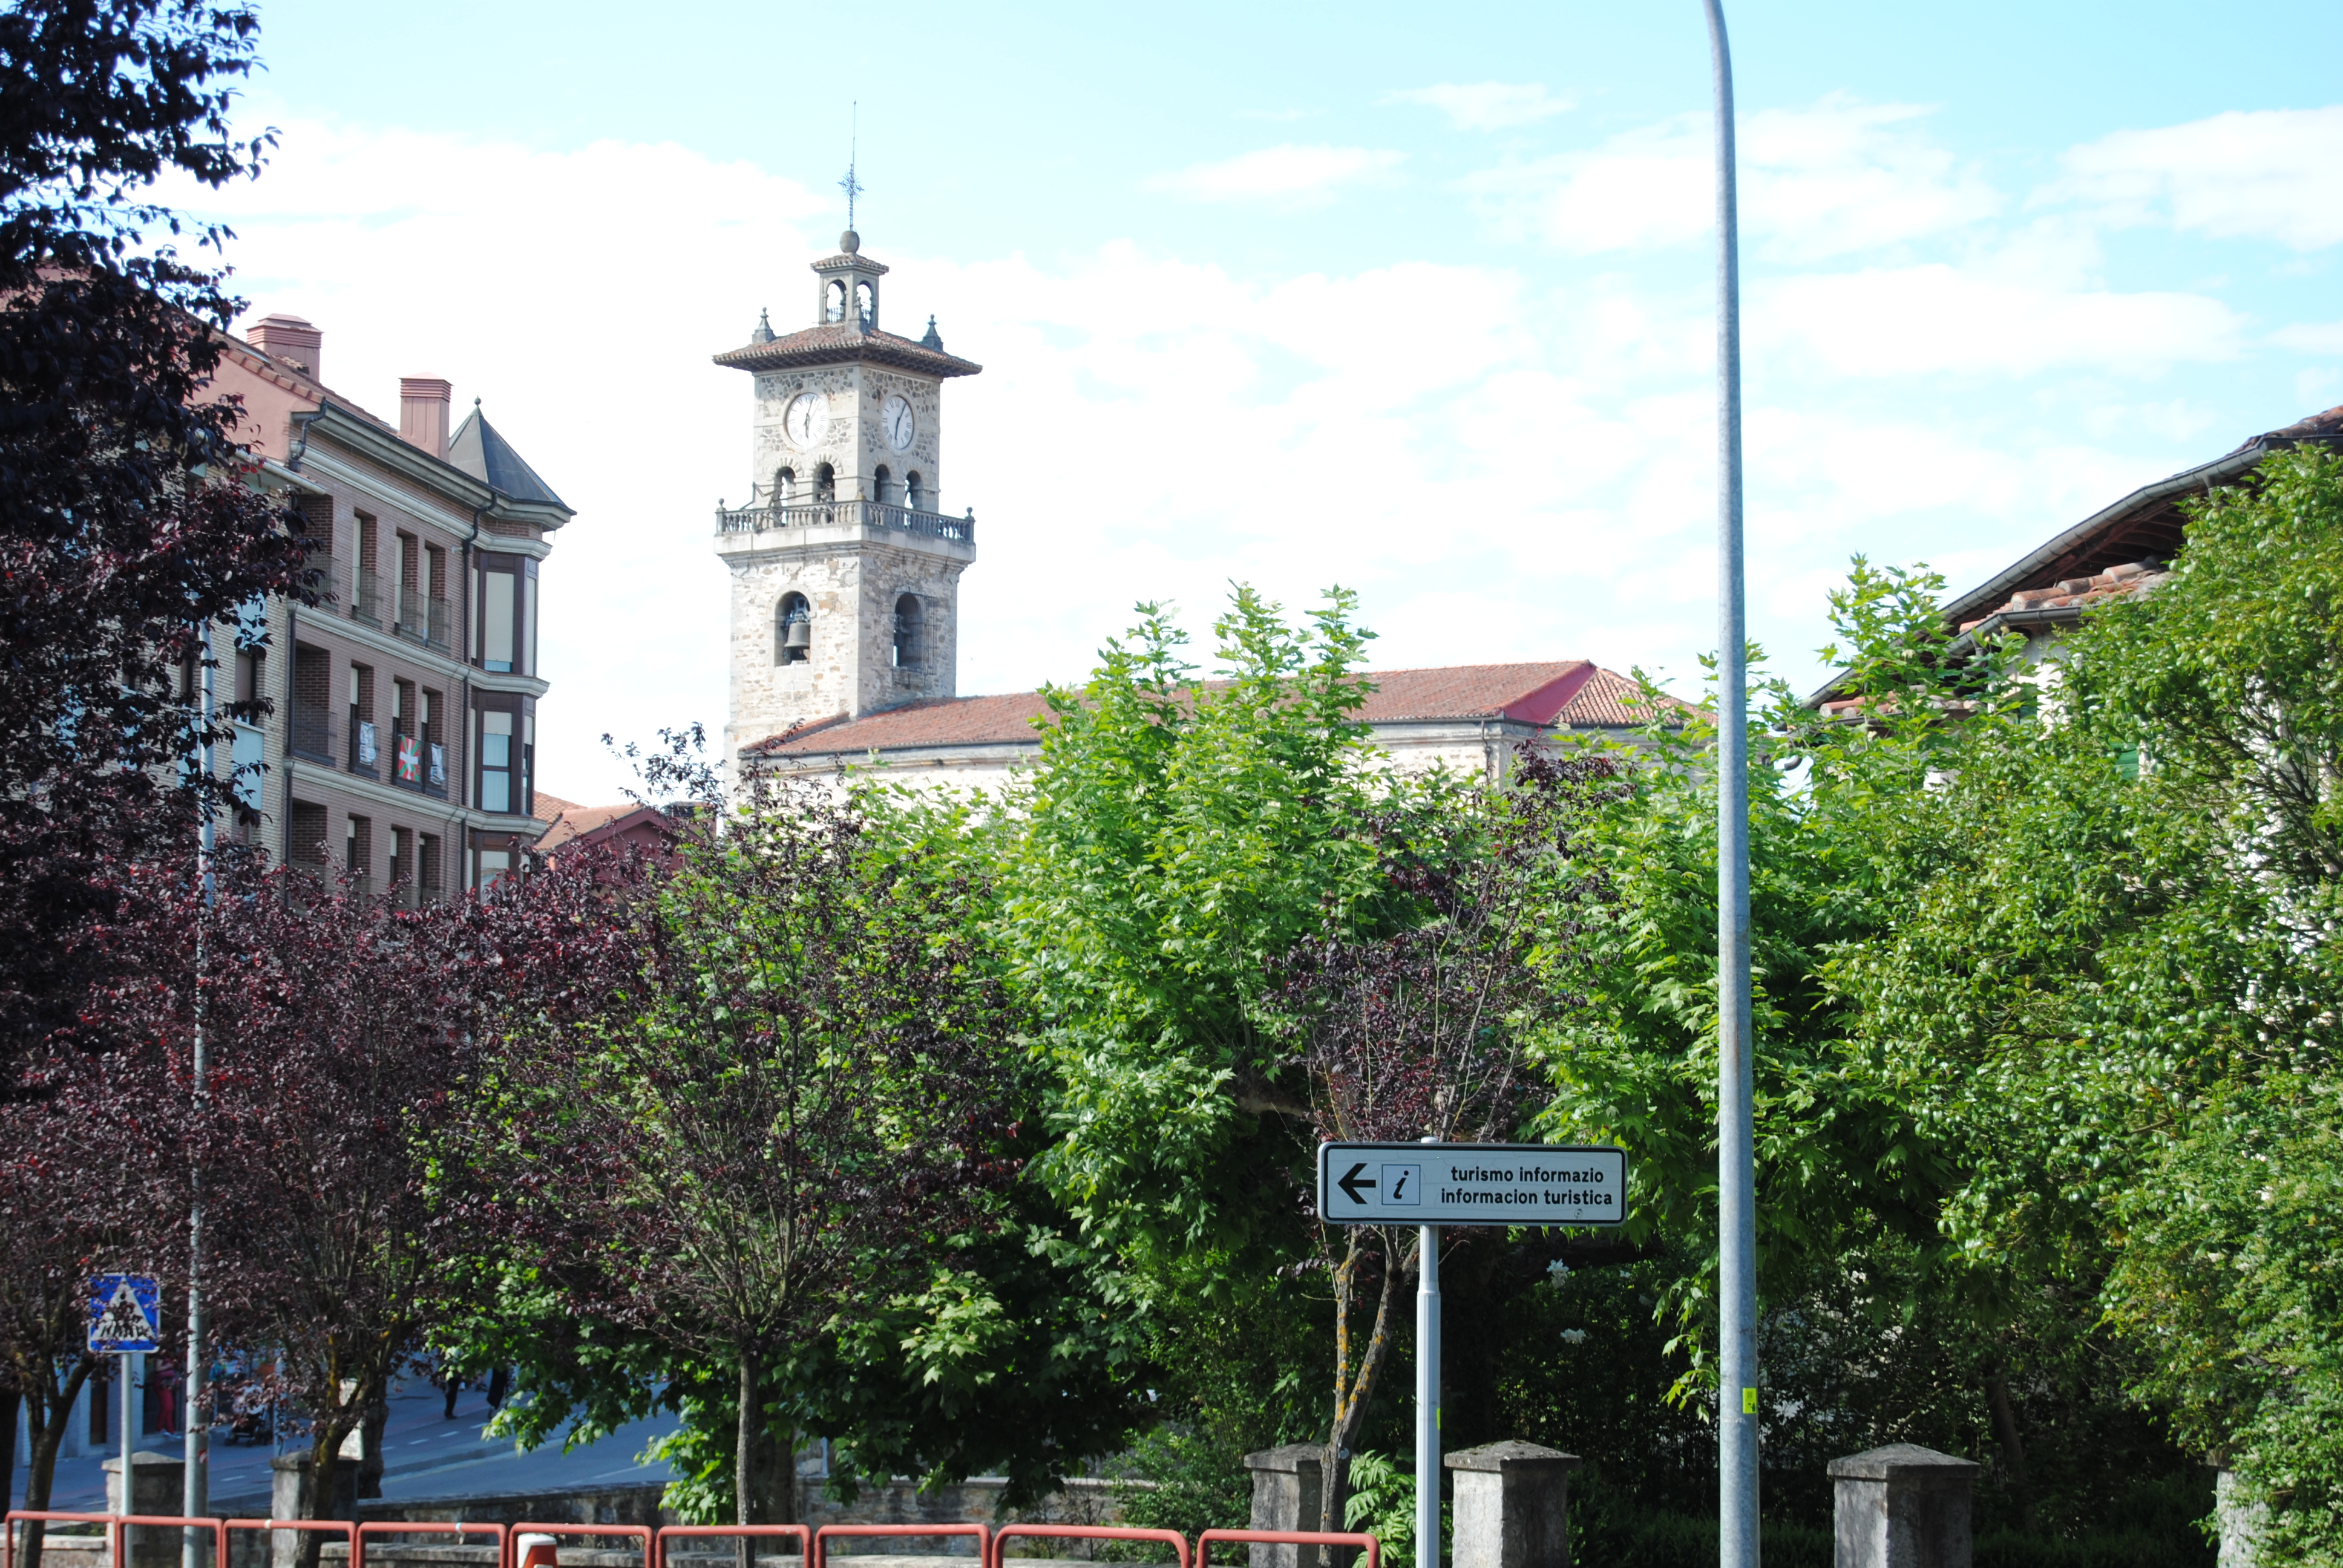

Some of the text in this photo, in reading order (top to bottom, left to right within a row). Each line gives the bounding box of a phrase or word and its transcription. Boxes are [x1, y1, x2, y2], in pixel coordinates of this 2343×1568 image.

[1451, 1166, 1604, 1183] turismo informazio
[1441, 1188, 1613, 1205] informacion turistica
